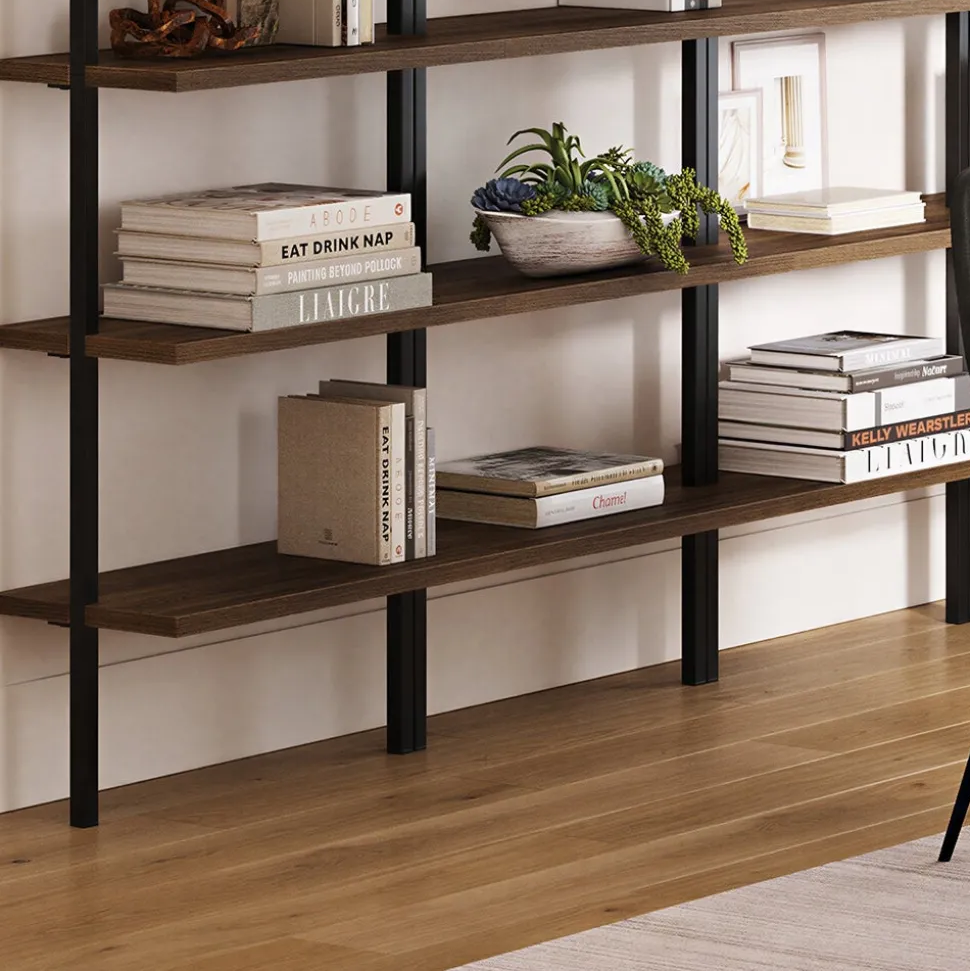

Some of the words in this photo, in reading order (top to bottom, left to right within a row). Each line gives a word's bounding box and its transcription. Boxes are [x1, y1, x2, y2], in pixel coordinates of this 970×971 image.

[309, 204, 372, 228] ABODE
[281, 242, 309, 260] EAT
[313, 237, 360, 255] DRINK
[363, 231, 394, 248] NAP
[287, 268, 327, 286] PAINTING
[328, 262, 363, 281] BEYOND
[364, 256, 402, 275] POLLOCK
[298, 281, 391, 324] LIAIGRE
[865, 347, 913, 364] MINIMAL
[381, 425, 390, 455] EAT
[851, 425, 892, 447] KELLY
[381, 458, 390, 509] DRINK
[381, 510, 390, 543] NAP
